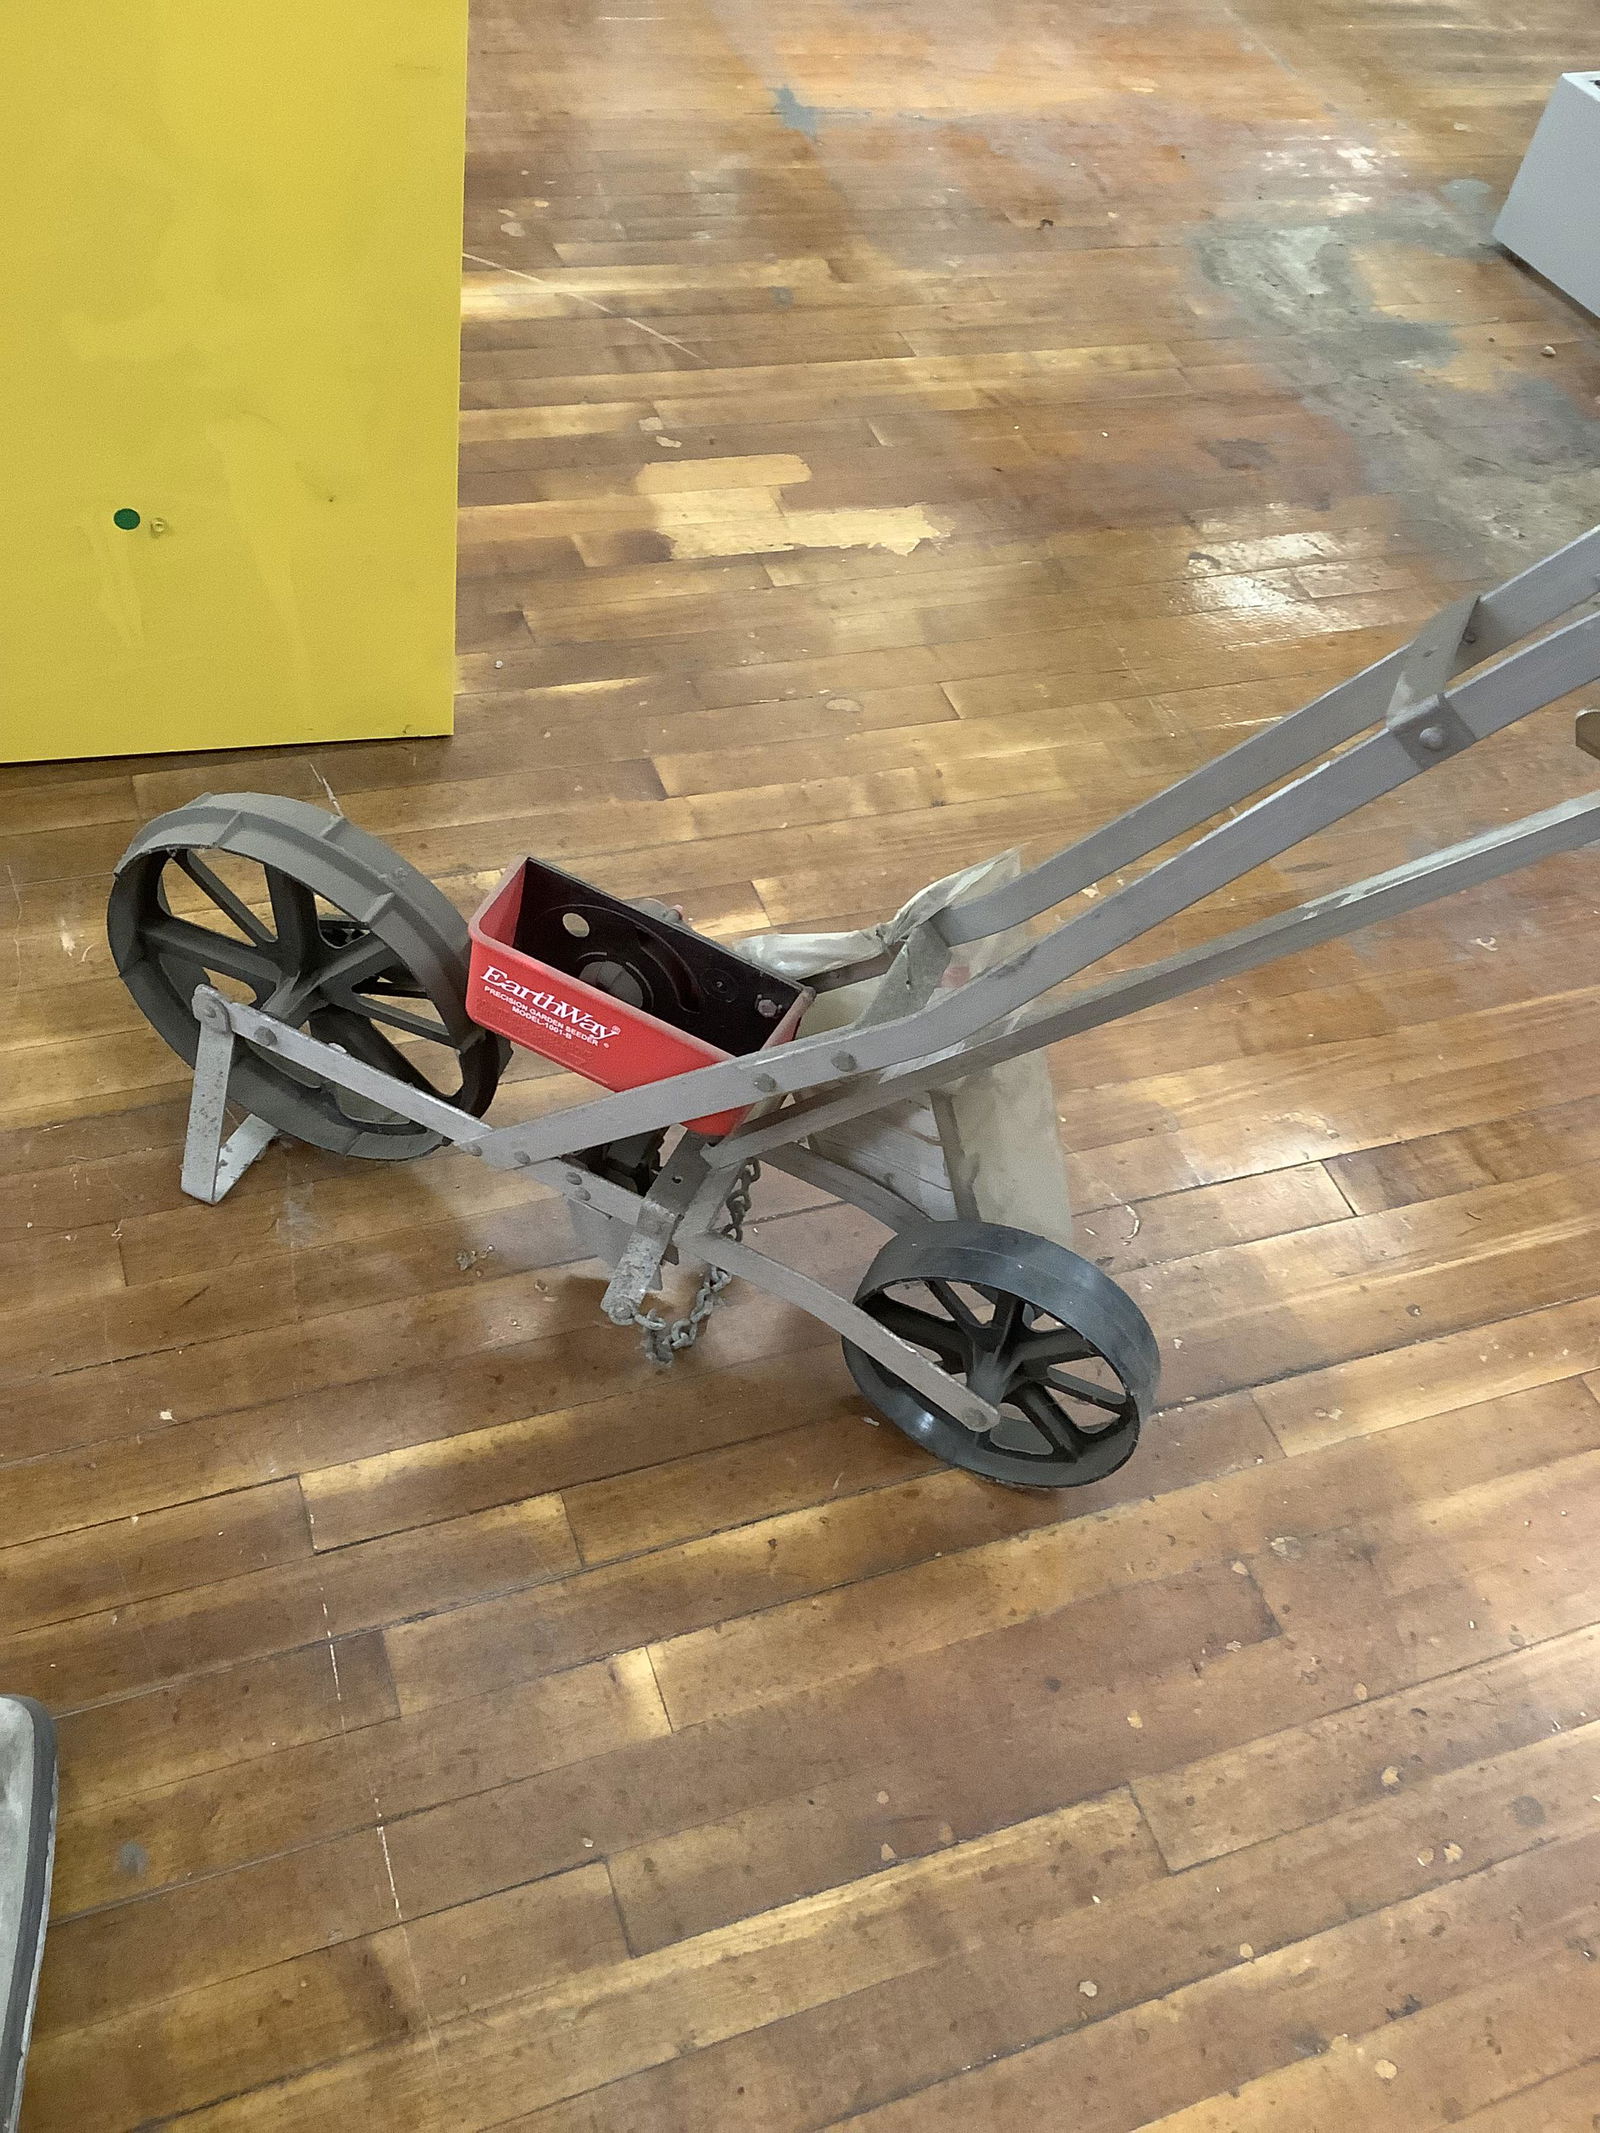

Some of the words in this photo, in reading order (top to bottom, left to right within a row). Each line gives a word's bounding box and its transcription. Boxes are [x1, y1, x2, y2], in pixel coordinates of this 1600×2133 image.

[484, 985, 528, 1011] PRECISION
[530, 1008, 564, 1029] GARDEN
[565, 1026, 599, 1047] SEEDER
[511, 1006, 572, 1040] MODEL-1001-B
